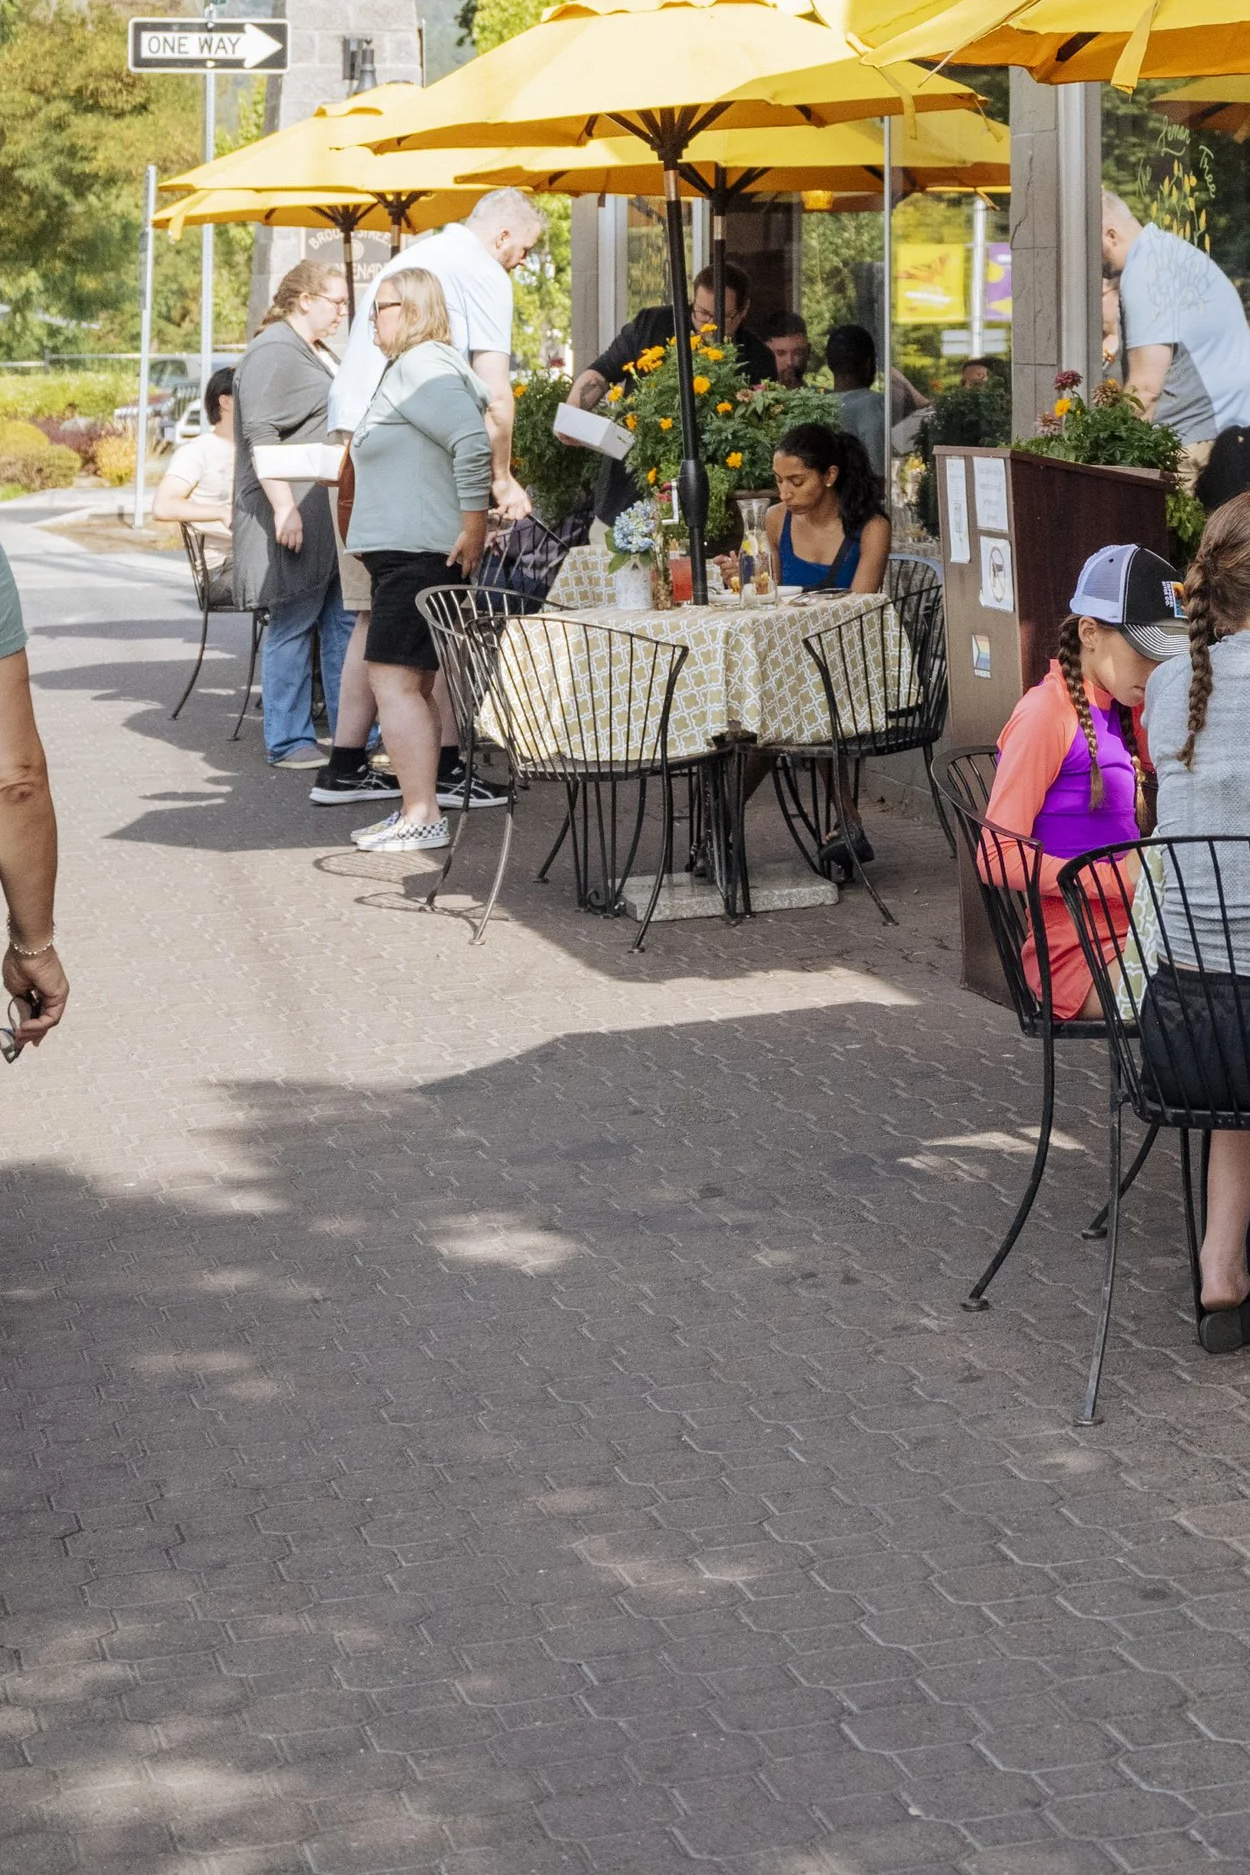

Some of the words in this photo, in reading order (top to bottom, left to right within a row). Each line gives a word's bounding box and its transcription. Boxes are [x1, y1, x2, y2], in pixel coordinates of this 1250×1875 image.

[148, 35, 189, 55] ONE
[198, 35, 241, 55] WAY
[1157, 114, 1192, 157] Lemon
[1199, 145, 1217, 199] Tree
[308, 228, 345, 250] BROO
[356, 230, 393, 247] STREE
